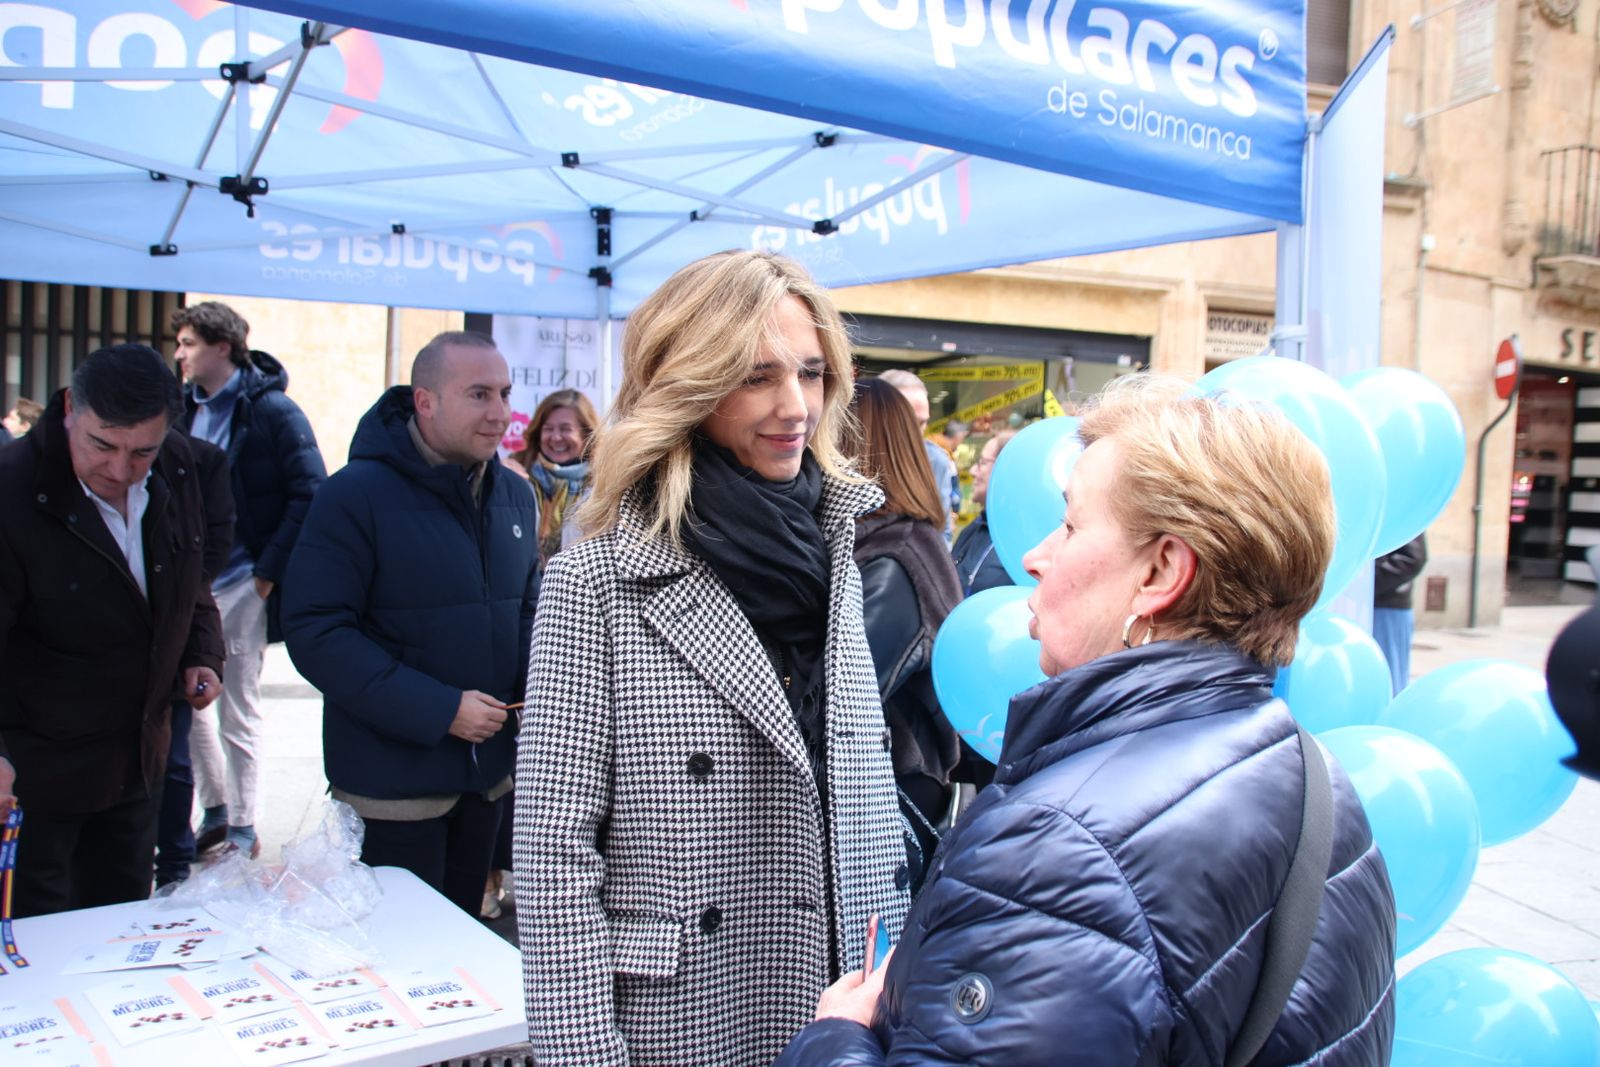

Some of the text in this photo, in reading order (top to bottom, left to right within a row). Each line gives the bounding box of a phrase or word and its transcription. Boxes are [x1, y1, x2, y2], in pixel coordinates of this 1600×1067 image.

[1047, 79, 1252, 160] de Salamanca
[1208, 315, 1269, 335] OTOCOPIAS
[511, 366, 568, 388] FELIZ
[203, 979, 261, 998] MEJORES
[407, 983, 463, 999] MEJORES
[112, 997, 175, 1017] MEJORES
[325, 1002, 383, 1019] MEJORES
[0, 1018, 57, 1039] EJORES
[236, 1018, 299, 1040] MEJORES
